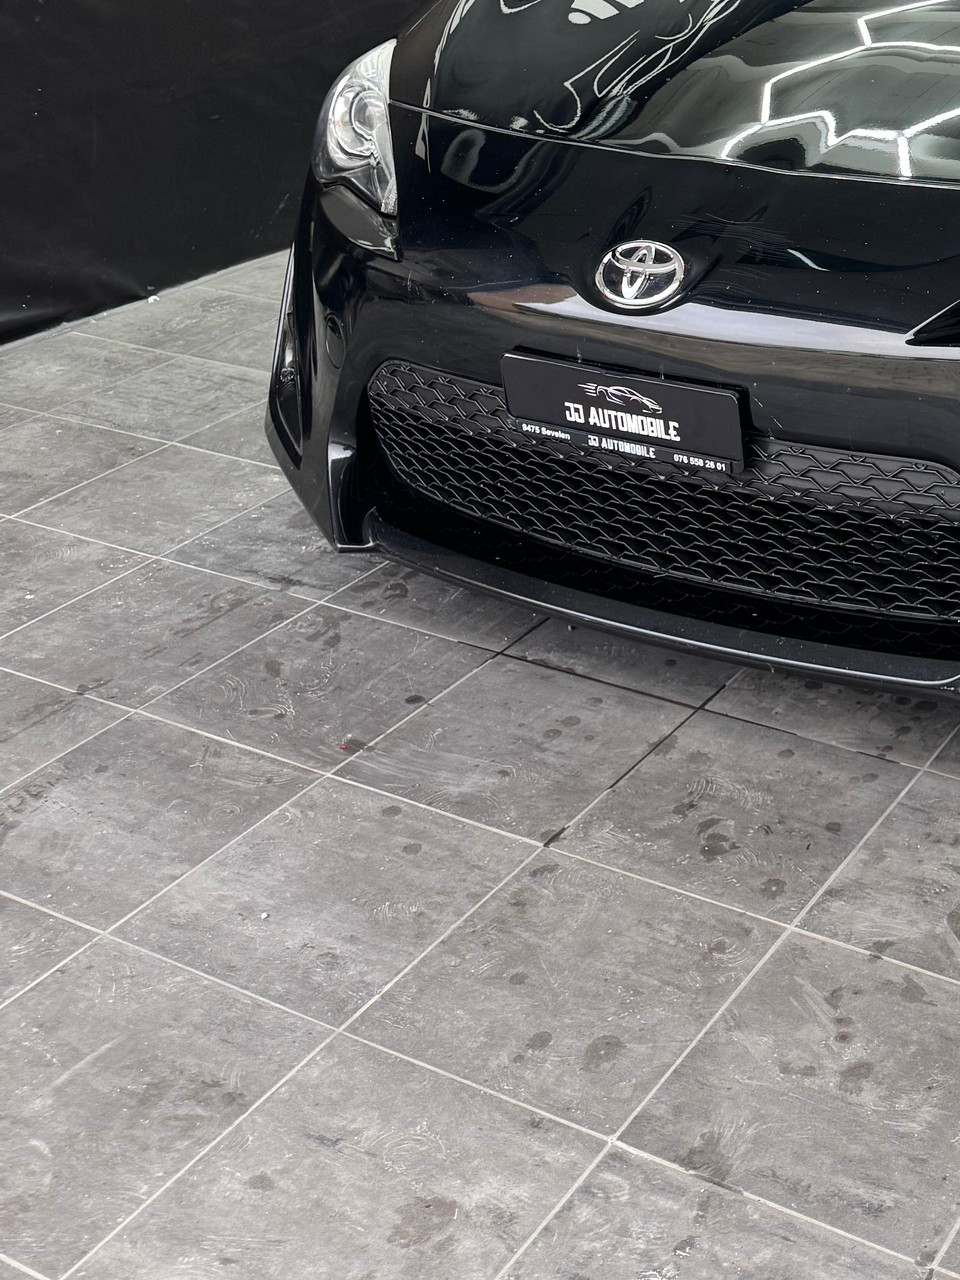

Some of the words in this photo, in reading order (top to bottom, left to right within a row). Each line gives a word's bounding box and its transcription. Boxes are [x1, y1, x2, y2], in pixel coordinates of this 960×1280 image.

[521, 423, 540, 434] 9475
[541, 427, 571, 440] Sevelen
[564, 402, 585, 423] JJ
[589, 406, 681, 441] AUTOMOBILE
[588, 435, 599, 446] JJ
[601, 438, 656, 458] AUTOMOBILE
[673, 454, 688, 463] 076
[689, 457, 704, 466] 558
[705, 460, 715, 469] 26
[716, 462, 726, 471] 01
